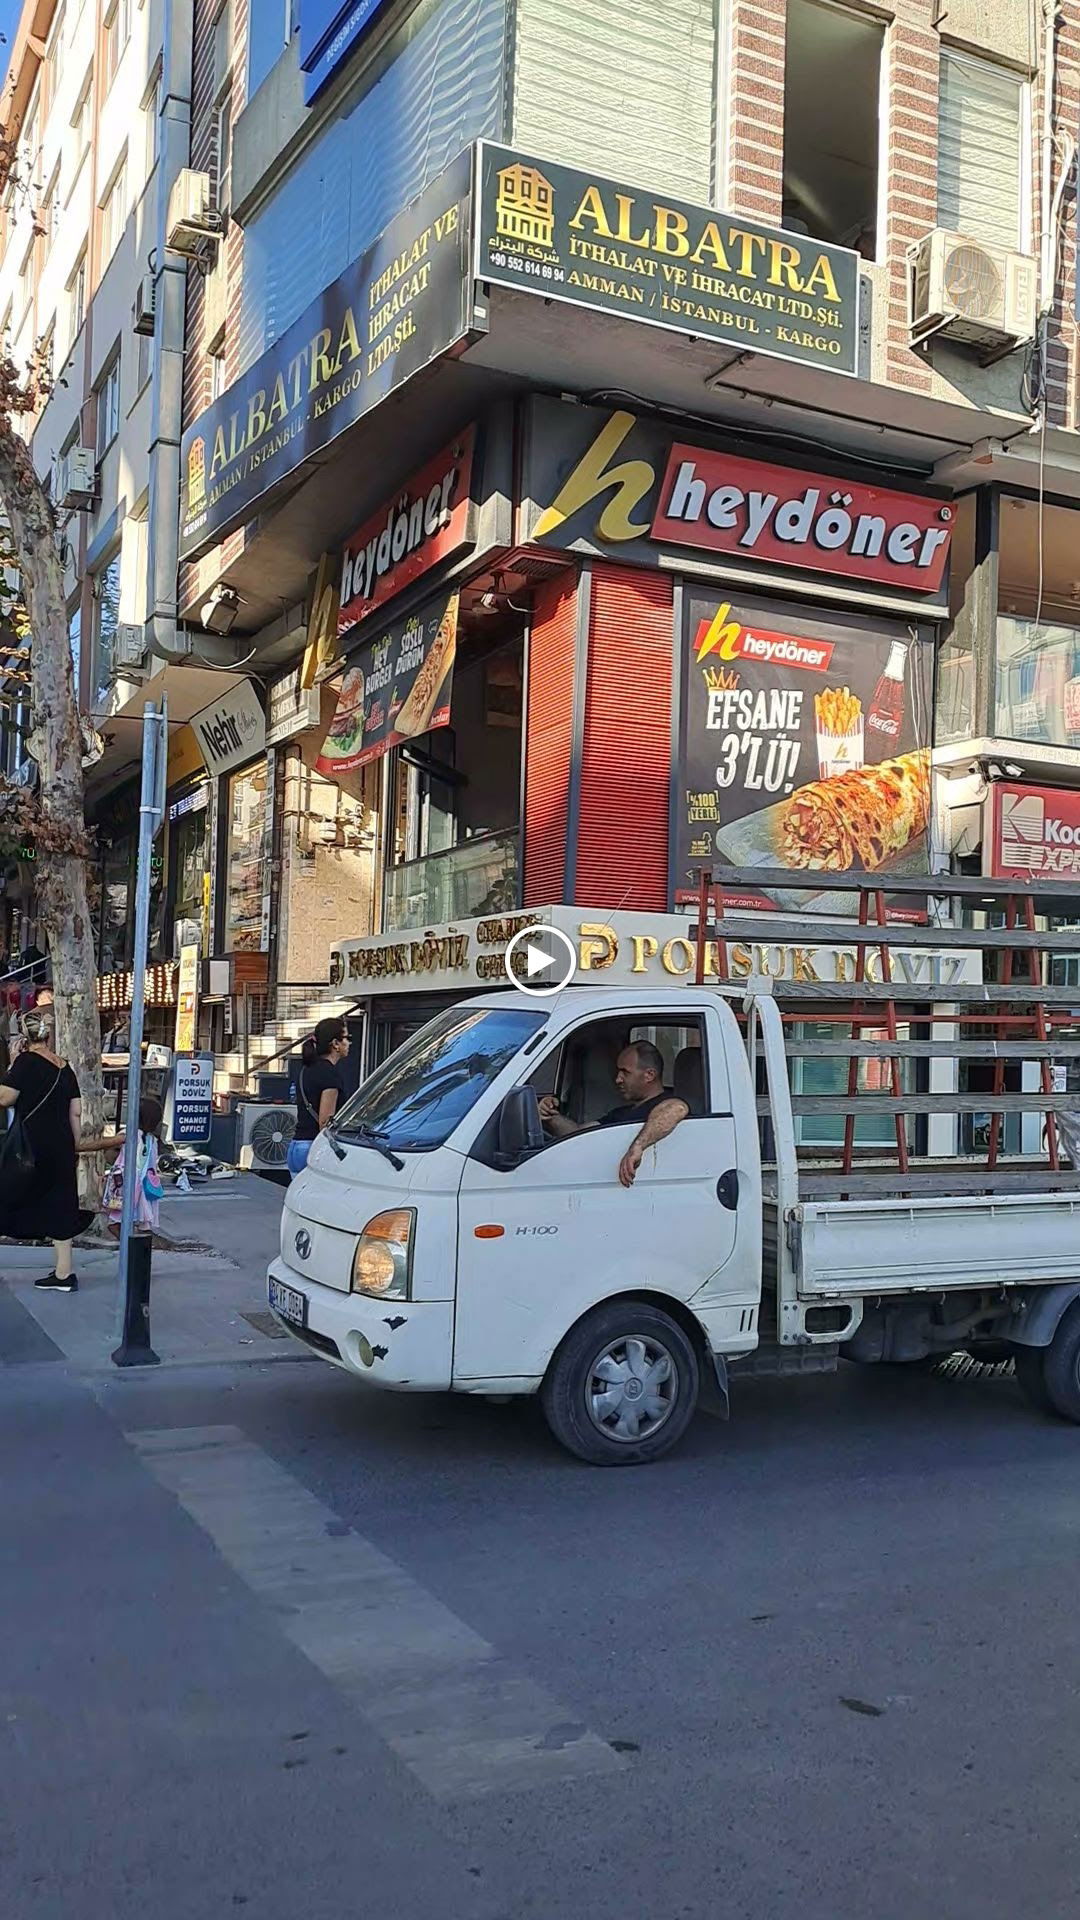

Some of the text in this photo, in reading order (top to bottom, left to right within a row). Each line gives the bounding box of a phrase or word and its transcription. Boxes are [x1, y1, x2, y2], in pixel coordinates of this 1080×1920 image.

[368, 203, 459, 312] İTHALAT VE
[489, 252, 565, 282] +90 552 614 69 94
[527, 244, 560, 263] شركة
[568, 185, 842, 302] ALBATRA
[568, 234, 658, 278] İTHALAT
[661, 263, 687, 286] VE
[691, 268, 776, 312] İHRACAT
[368, 260, 432, 344] İHRACAT
[566, 270, 645, 303] AMMAN
[661, 292, 760, 334] İSTANBUL
[776, 325, 842, 356] KARGO
[209, 306, 362, 480] ALBATRA
[313, 368, 361, 420] KARGO
[340, 468, 456, 610] heydöner
[667, 462, 949, 567] heydöner
[743, 633, 827, 665] heydöner
[200, 709, 243, 762] Nehir
[706, 689, 803, 730] EFSANE
[177, 1105, 209, 1113] PORSUK
[179, 1079, 210, 1087] PORSUK
[515, 1226, 558, 1235] H-100
